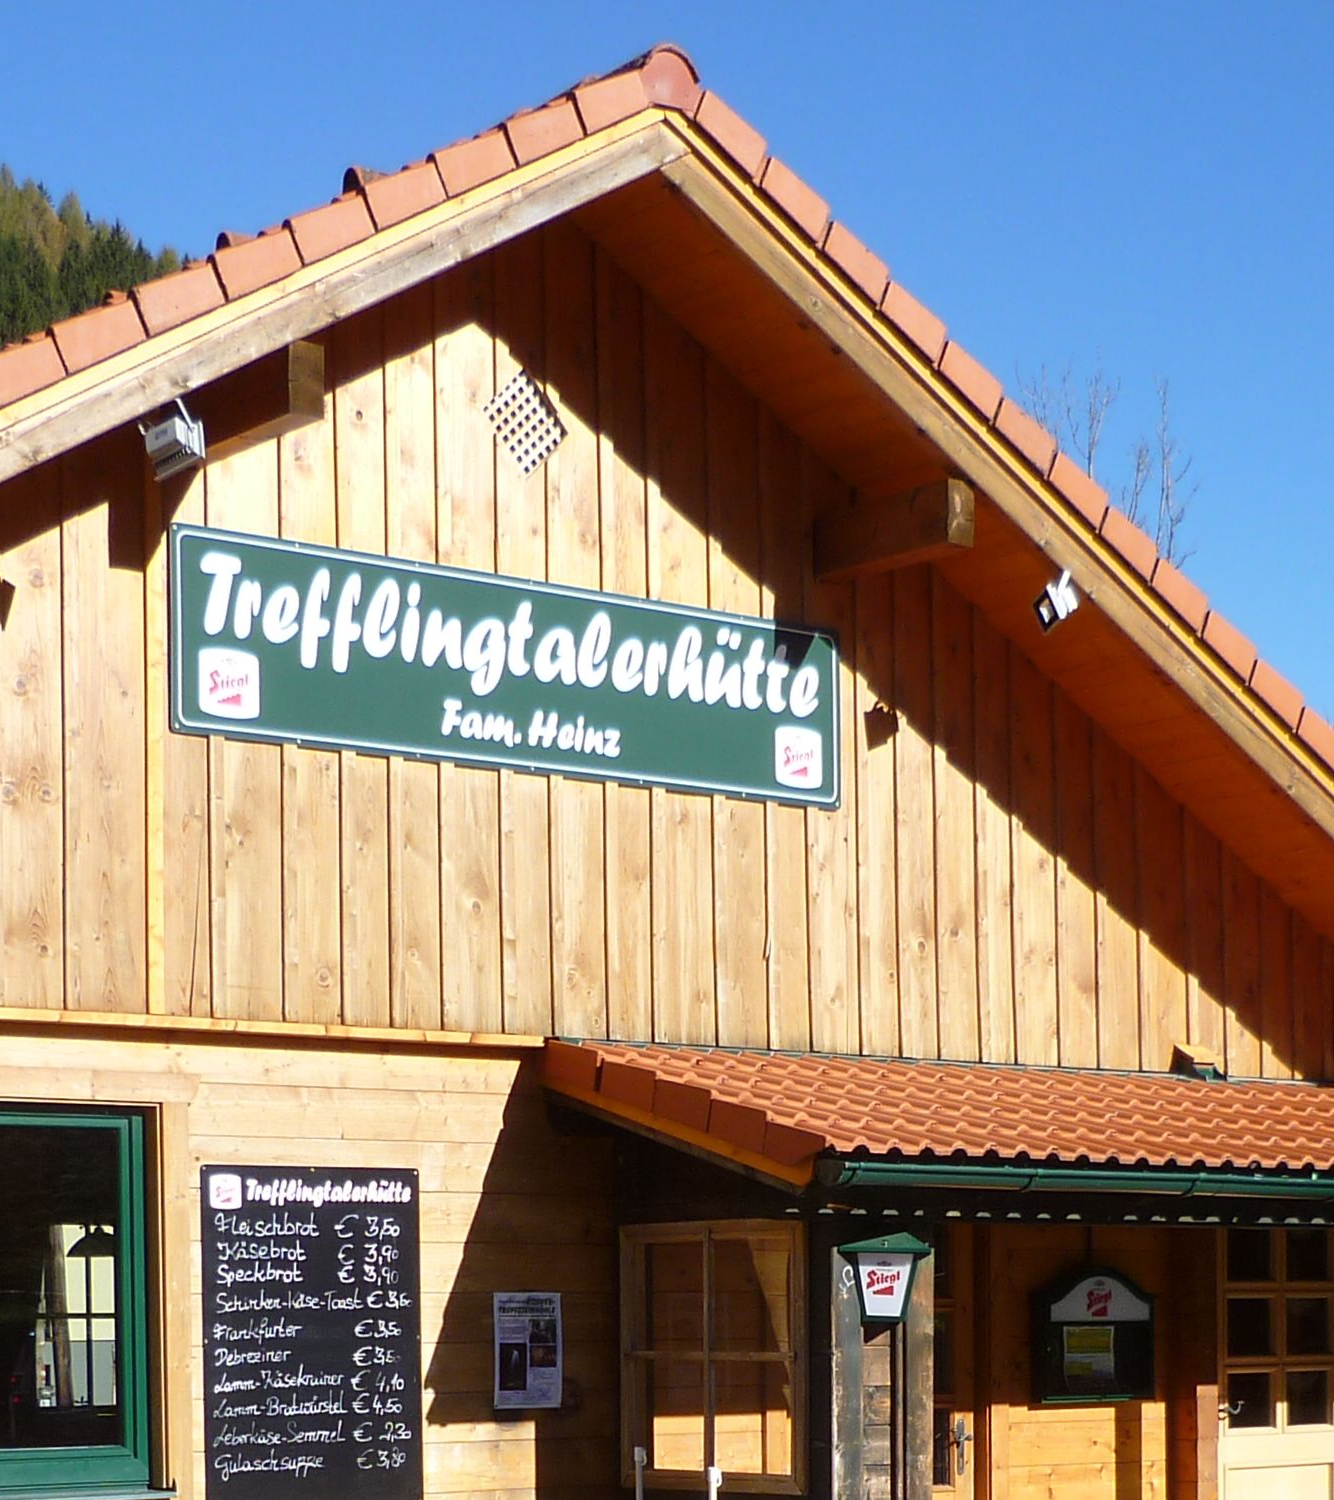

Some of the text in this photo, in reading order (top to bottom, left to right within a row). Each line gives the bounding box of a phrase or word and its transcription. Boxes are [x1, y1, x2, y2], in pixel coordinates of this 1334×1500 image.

[200, 552, 819, 718] Trefflingtalerhütte
[441, 698, 621, 758] Fam. Heinz
[245, 1179, 411, 1207] Trefflingtalerhütte
[215, 1212, 400, 1240] Fleischbrot € 3,50
[217, 1240, 399, 1265] Käsebrot € 3,90
[217, 1261, 399, 1287] Speckbrot € 3,90
[867, 1267, 900, 1289] Stiegl
[213, 1317, 303, 1344] Frankfurter
[214, 1448, 327, 1481] Gulaschsuppe
